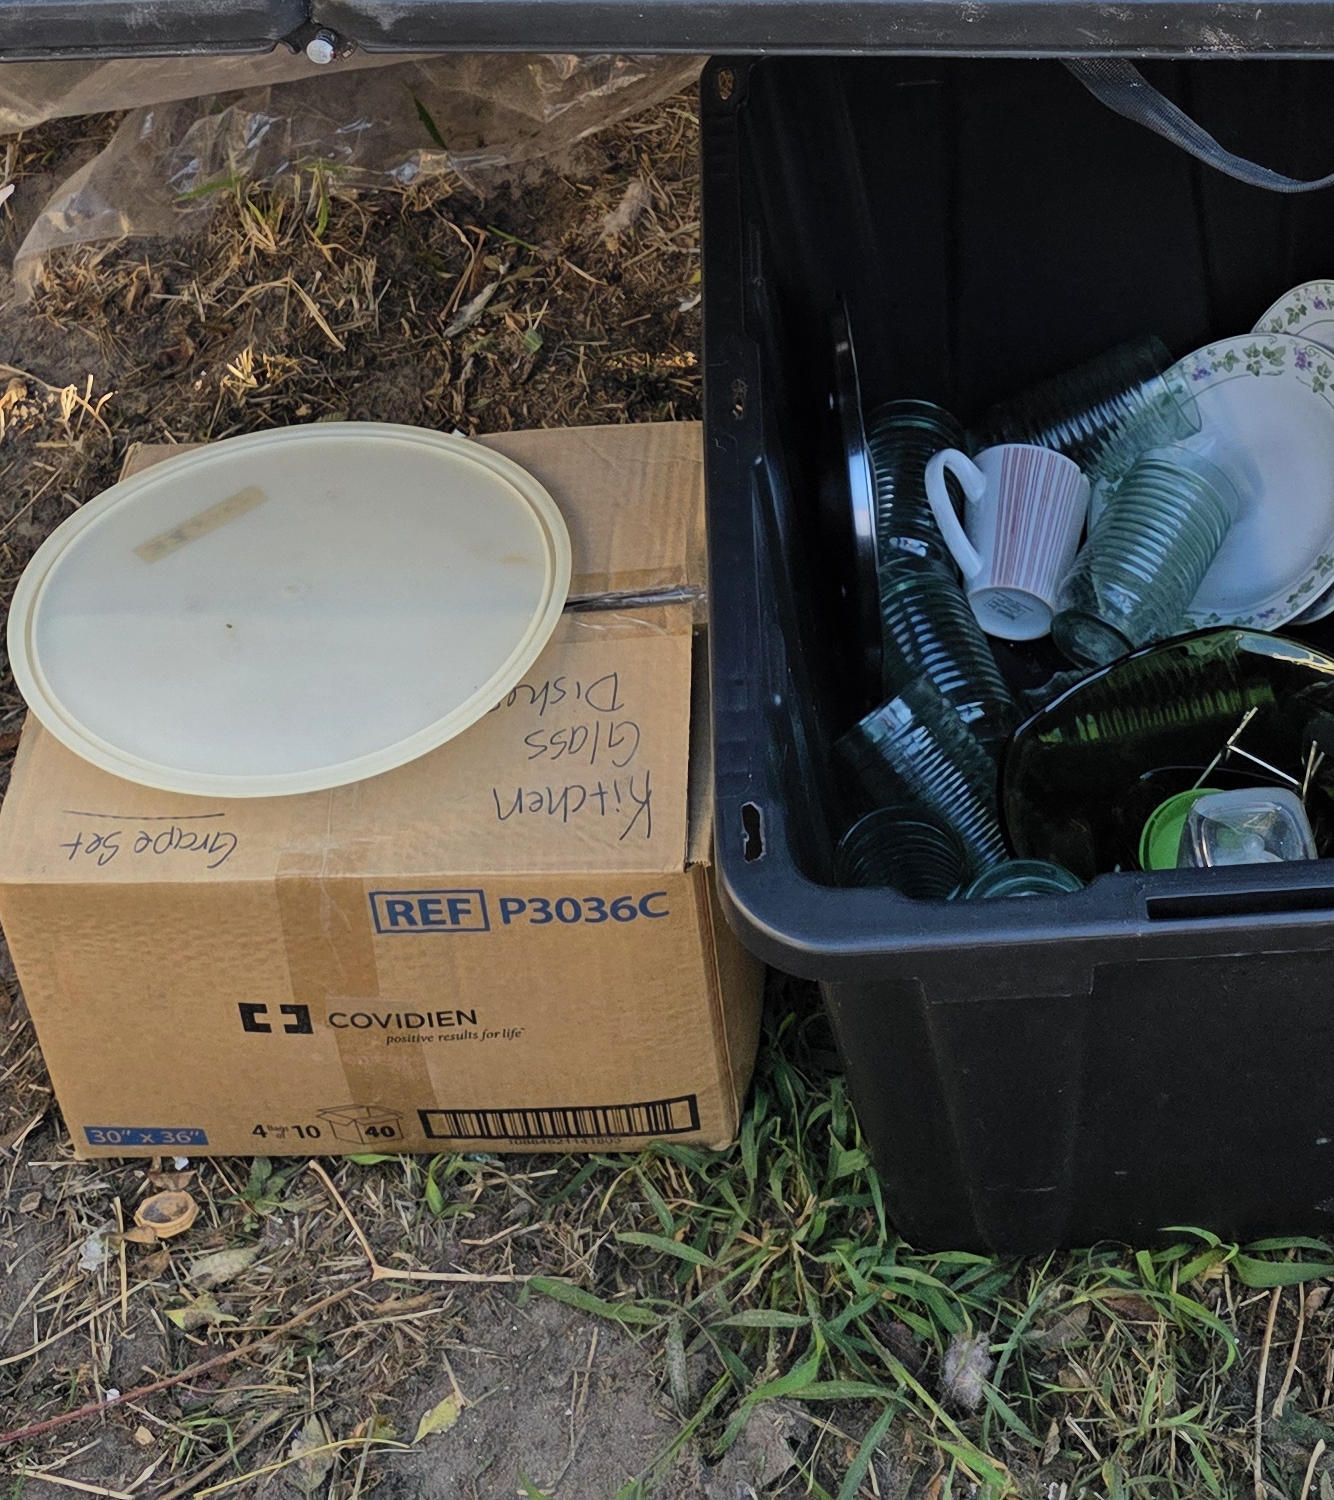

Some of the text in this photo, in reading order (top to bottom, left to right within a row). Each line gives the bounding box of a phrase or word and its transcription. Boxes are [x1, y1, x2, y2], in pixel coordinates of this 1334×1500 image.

[523, 718, 640, 766] Glass
[493, 769, 653, 841] Kitchen
[59, 825, 239, 869] Grape Set
[385, 891, 670, 927] REF P3036C
[328, 1009, 478, 1029] COVIDIEN
[386, 1032, 434, 1046] positive
[438, 1030, 478, 1042] results
[481, 1029, 500, 1042] for
[139, 1132, 155, 1143] x
[252, 1124, 267, 1138] 4
[292, 1124, 321, 1139] 10
[365, 1125, 395, 1138] 40
